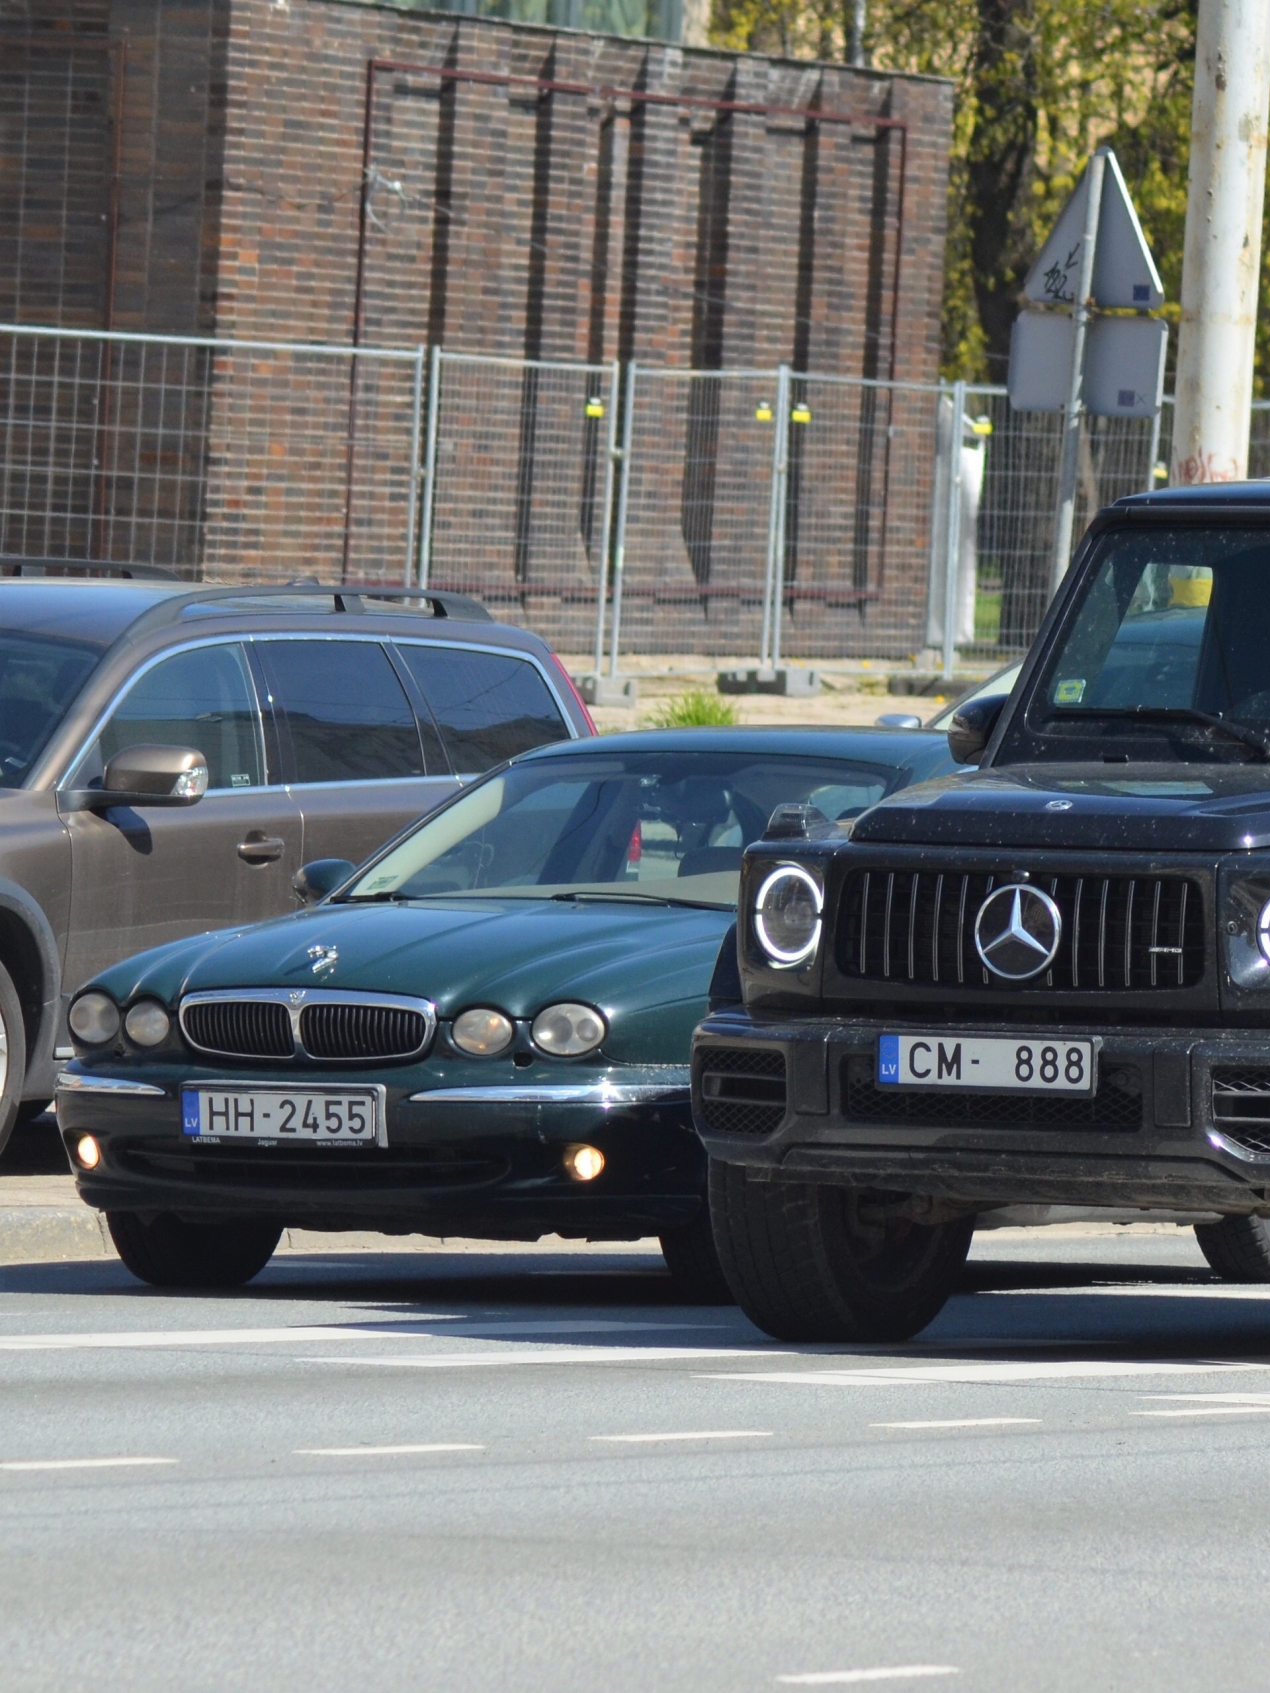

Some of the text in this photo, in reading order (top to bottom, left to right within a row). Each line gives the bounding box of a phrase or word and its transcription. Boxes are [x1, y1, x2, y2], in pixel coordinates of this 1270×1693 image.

[881, 1064, 897, 1075] LV
[1015, 1045, 1084, 1084] 888
[208, 1097, 366, 1134] HH-2455
[184, 1118, 199, 1128] LV
[192, 1136, 363, 1147] LATBEMA Jaguar www.latbema.lv
